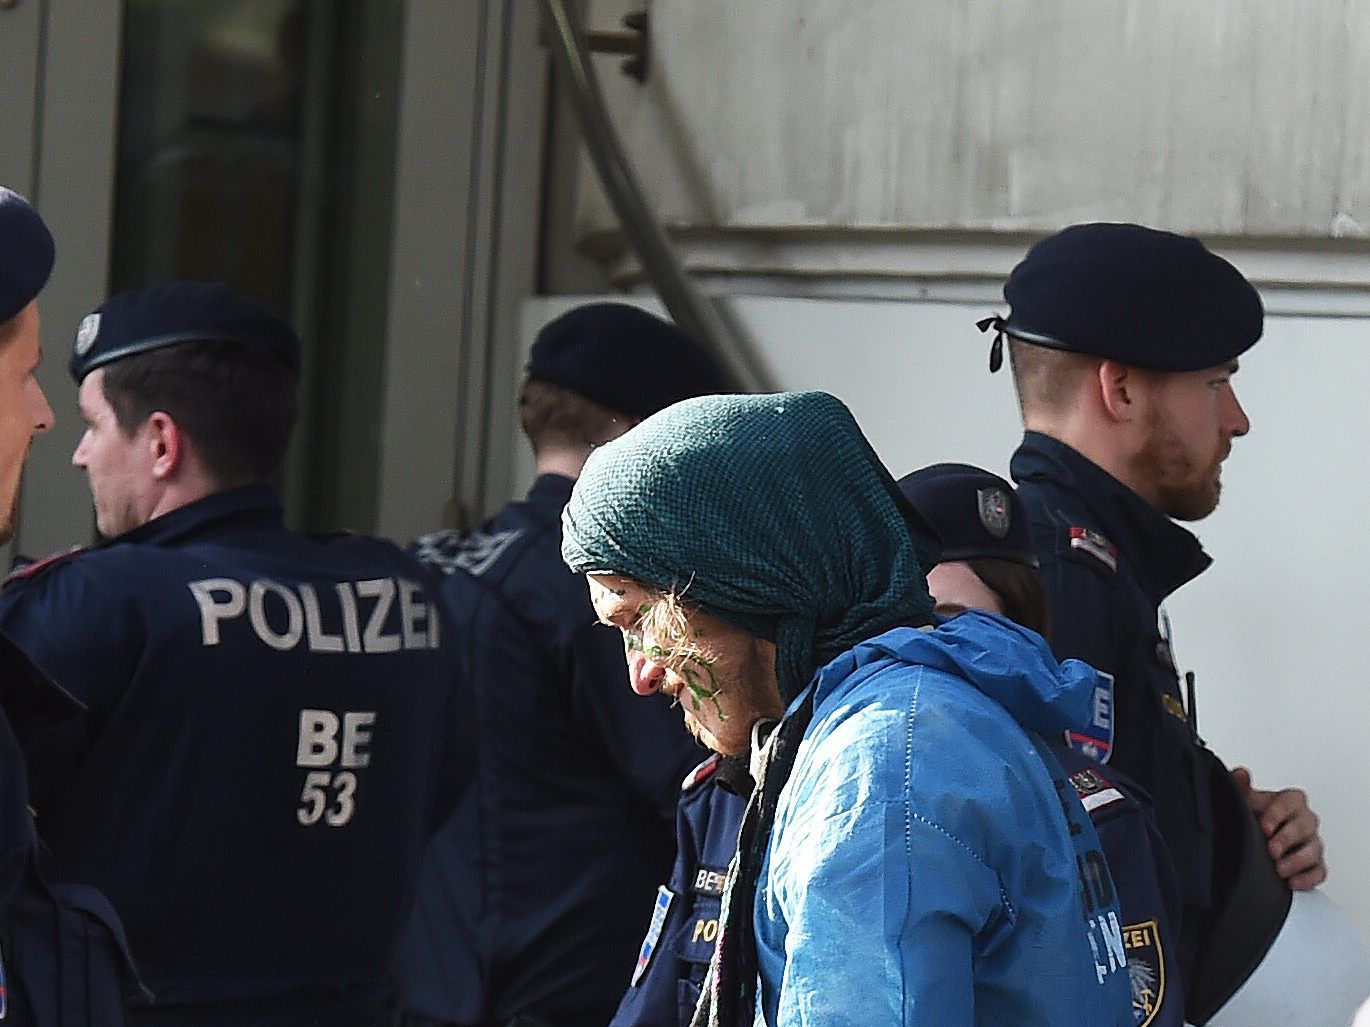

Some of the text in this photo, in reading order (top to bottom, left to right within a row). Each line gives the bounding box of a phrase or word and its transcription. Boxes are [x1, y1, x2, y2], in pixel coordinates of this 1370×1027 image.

[187, 577, 441, 653] POLIZEI
[296, 708, 377, 768] BE
[296, 770, 357, 827] 53
[692, 919, 718, 943] PO
